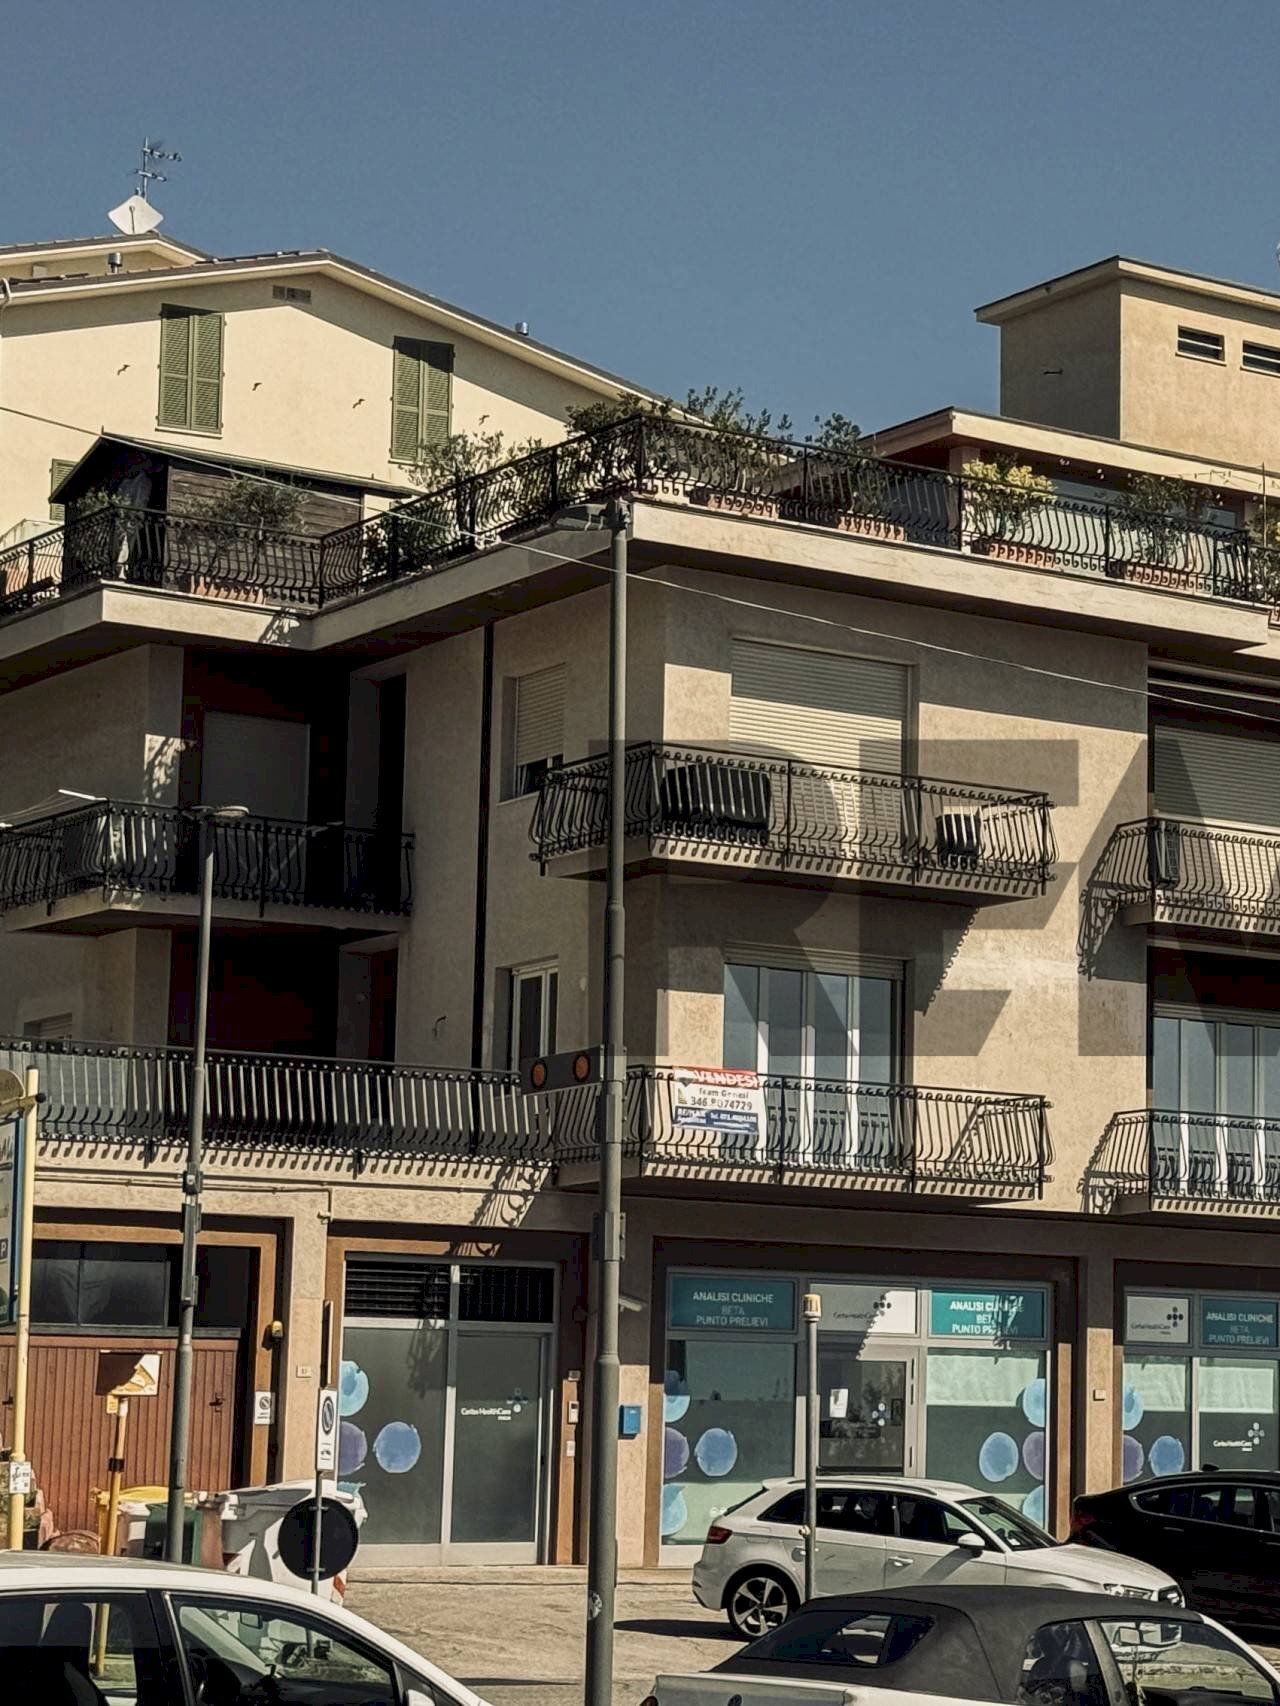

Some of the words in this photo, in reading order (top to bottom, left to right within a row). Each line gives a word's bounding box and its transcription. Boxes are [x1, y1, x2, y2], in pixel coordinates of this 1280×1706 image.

[691, 1096, 708, 1107] 346
[693, 1291, 729, 1301] ANALISI
[731, 1293, 774, 1303] CLINICHE
[721, 1305, 745, 1315] BETA
[950, 1301, 984, 1311] ANALISI
[696, 1315, 727, 1325] PUNTO
[729, 1317, 768, 1327] PRELIEVI
[1206, 1312, 1236, 1321] ANALISI
[952, 1324, 980, 1333] PUNTO
[1209, 1335, 1235, 1343] PUNTO
